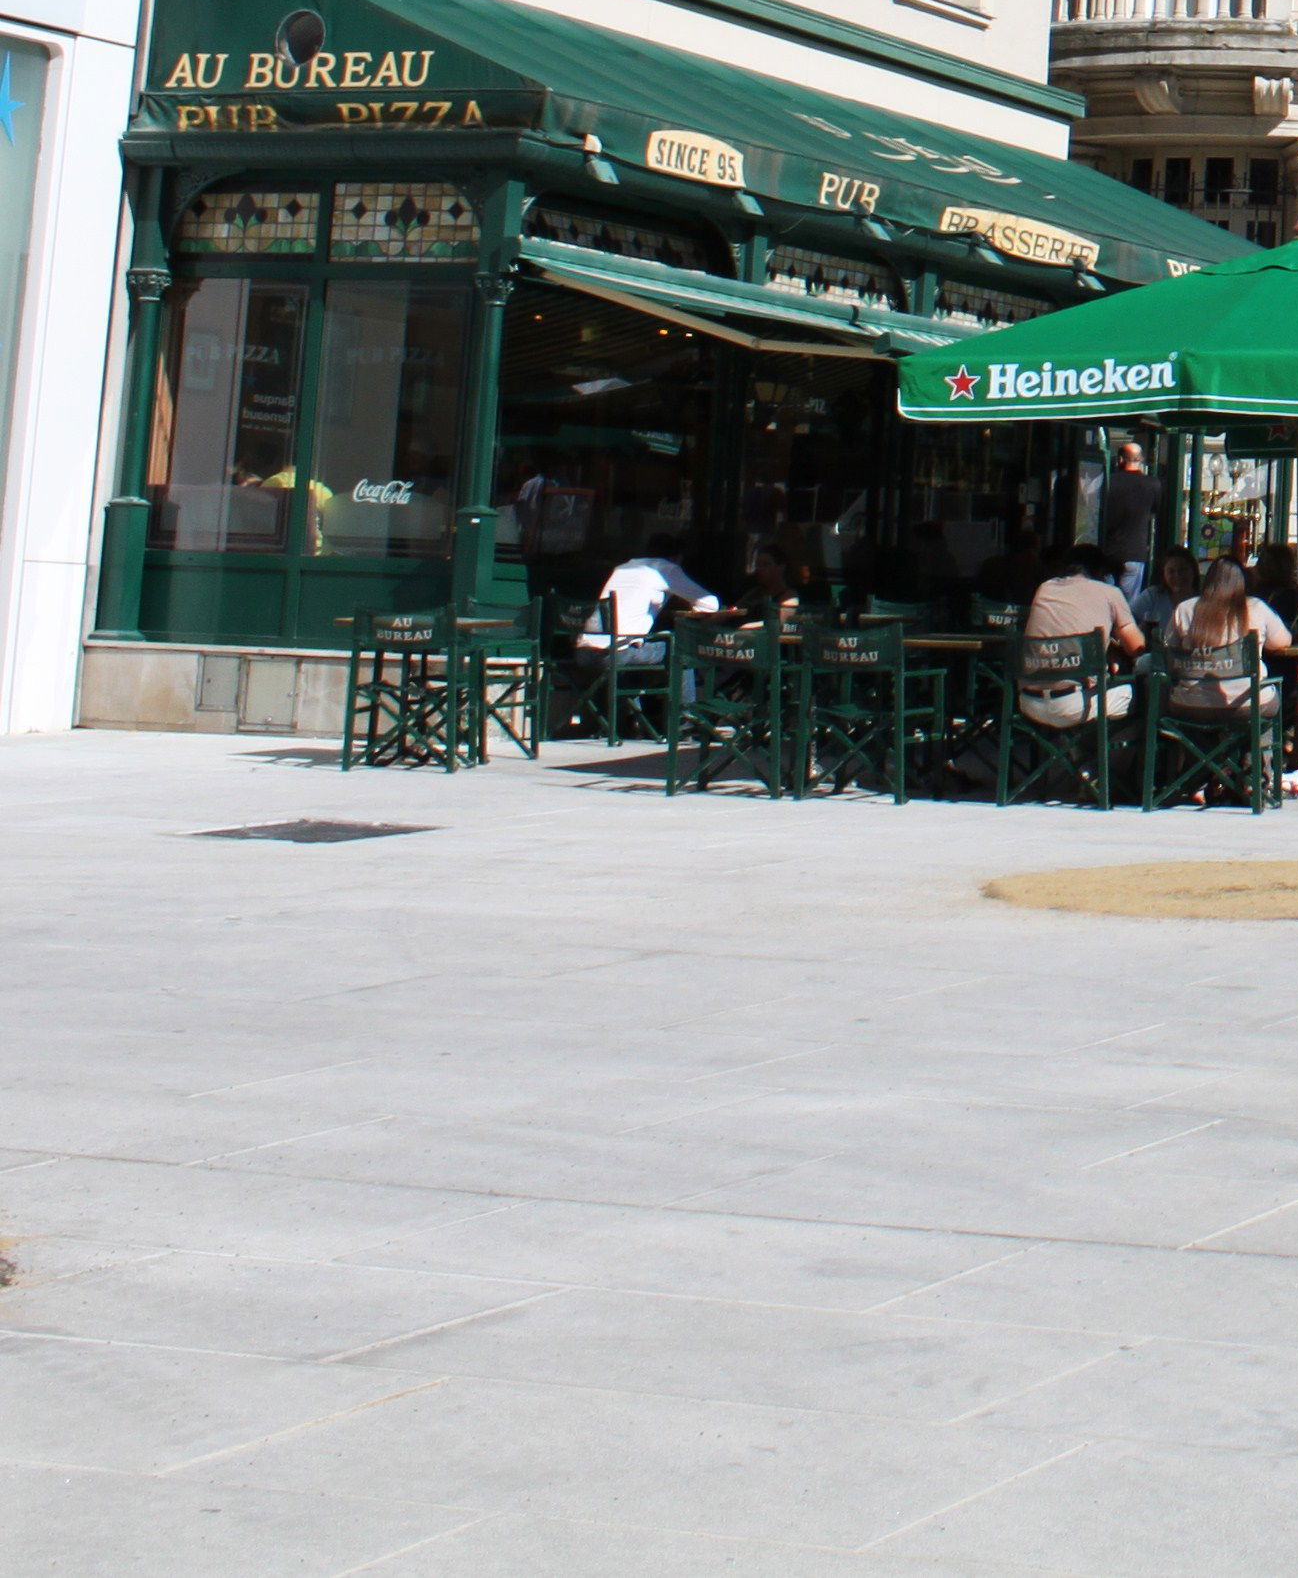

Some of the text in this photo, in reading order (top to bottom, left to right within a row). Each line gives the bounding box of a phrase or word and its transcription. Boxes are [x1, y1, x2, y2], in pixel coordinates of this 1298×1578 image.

[164, 50, 435, 89] AU BUREAU
[176, 100, 489, 132] PUB PIZZA
[655, 137, 736, 182] SINCE 95
[818, 171, 881, 214] PUB
[947, 211, 1094, 266] BRASSERIE
[986, 359, 1176, 400] Heineken
[392, 617, 413, 628] AU
[376, 629, 433, 641] BUREAU
[715, 634, 735, 645] AU
[838, 638, 858, 648] AU
[1040, 642, 1059, 654] AU
[698, 645, 755, 660] BUREAU
[823, 650, 879, 662] BUREAU
[1024, 656, 1081, 669] BUREAU
